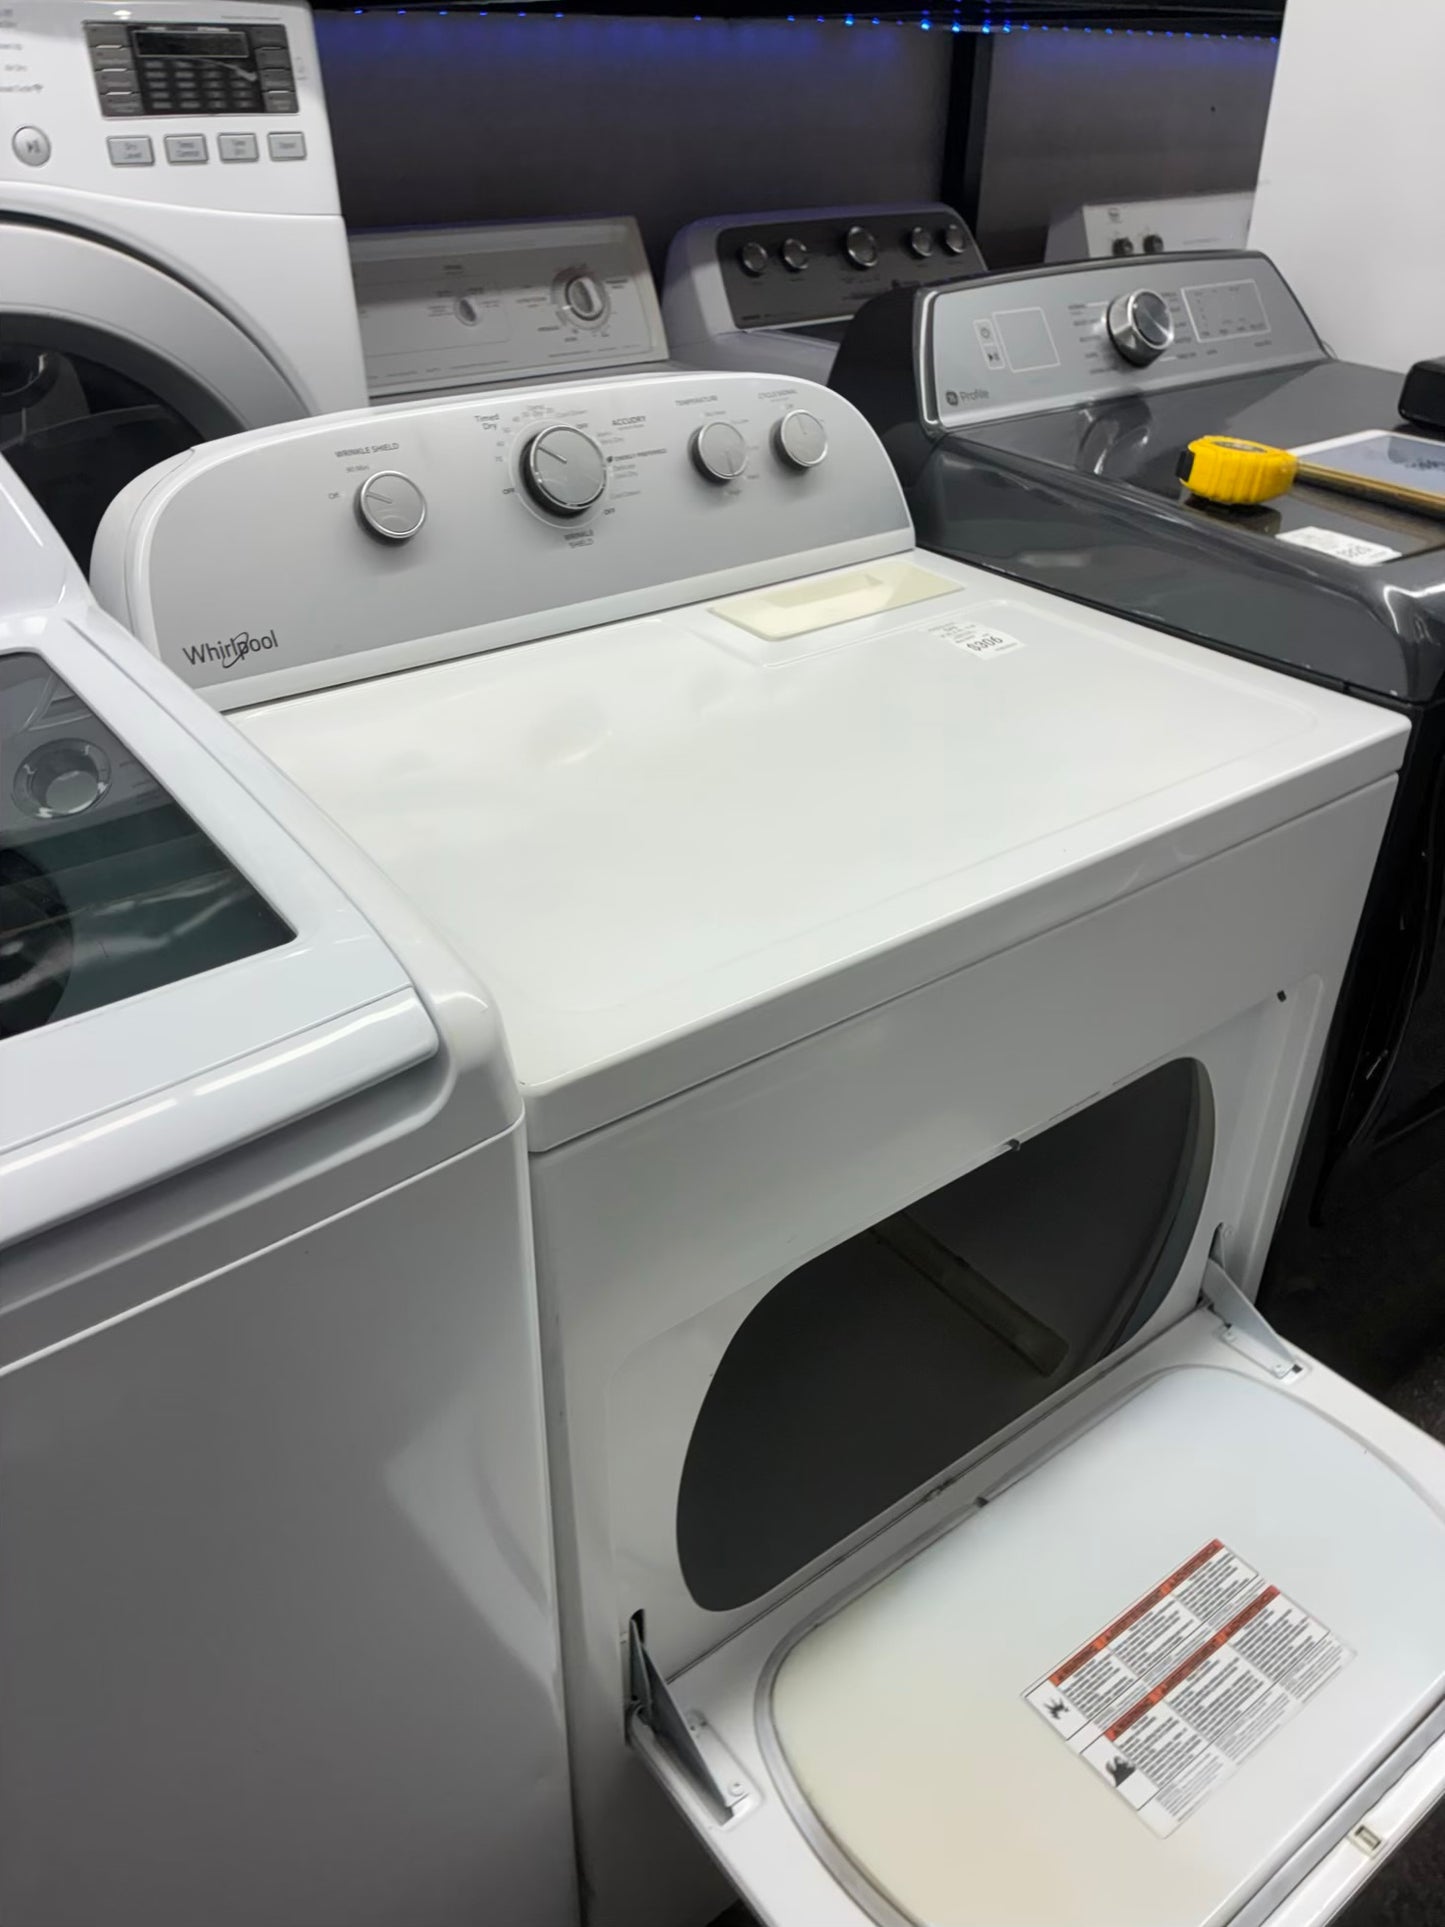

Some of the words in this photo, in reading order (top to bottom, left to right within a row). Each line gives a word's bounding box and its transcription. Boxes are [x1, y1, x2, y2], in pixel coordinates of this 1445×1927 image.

[475, 414, 499, 423] Timed
[483, 422, 497, 431] Dry
[335, 447, 370, 458] WRINKLE
[372, 443, 399, 453] SHIELD
[564, 530, 593, 541] WRINKLE
[569, 539, 593, 549] SHIELD
[182, 630, 278, 668] Whirlpool
